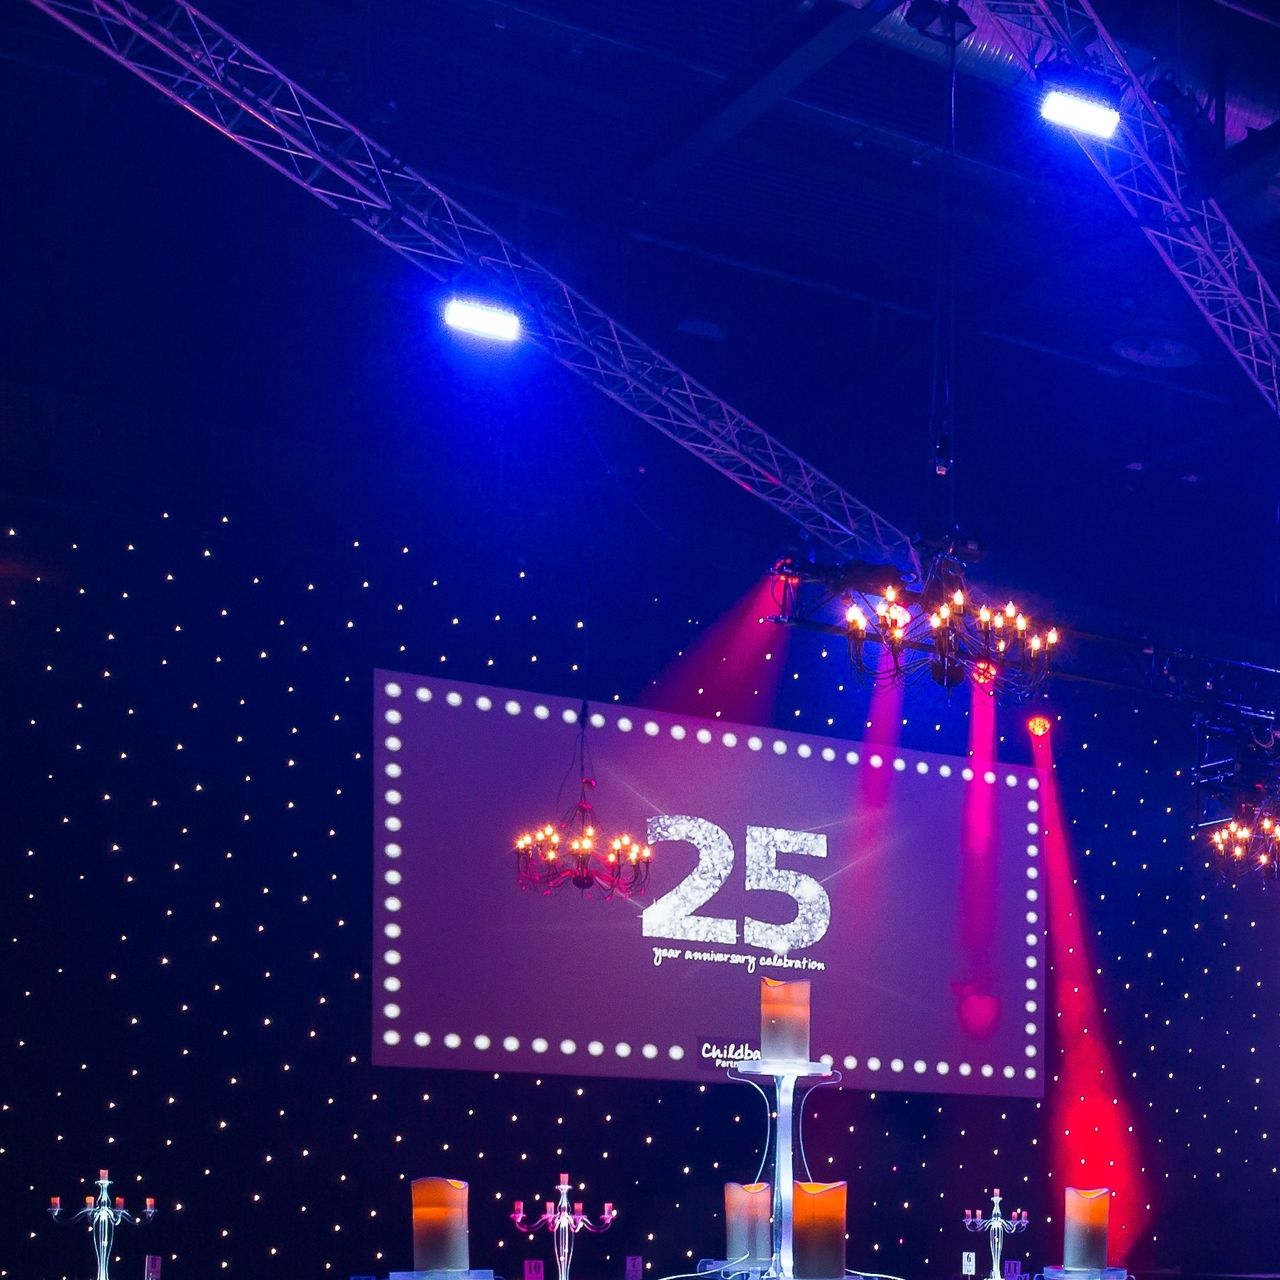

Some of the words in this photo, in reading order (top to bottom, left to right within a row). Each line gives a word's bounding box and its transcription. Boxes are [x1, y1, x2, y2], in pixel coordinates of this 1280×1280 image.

[643, 815, 832, 951] 25
[652, 946, 682, 966] year
[684, 949, 756, 973] anniversary
[759, 953, 826, 972] celebration
[701, 1042, 761, 1060] Childba
[966, 1253, 972, 1263] 6
[527, 1262, 541, 1274] 10
